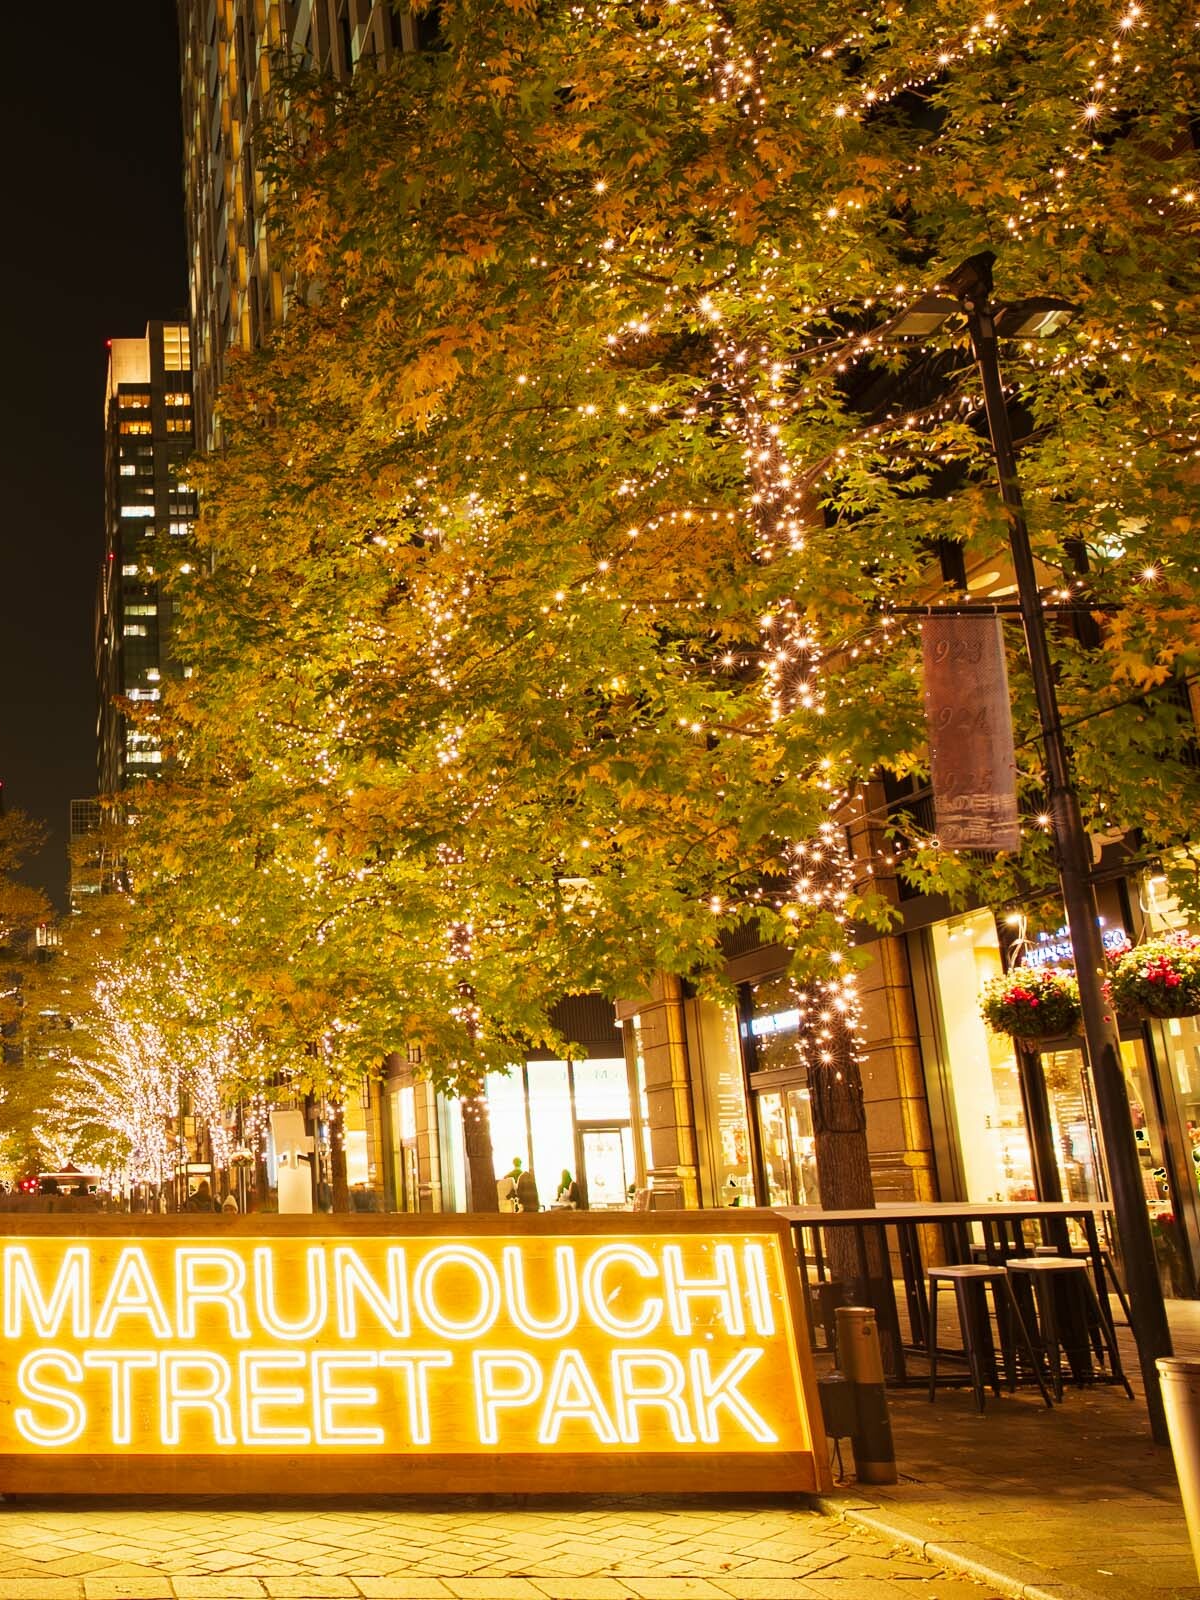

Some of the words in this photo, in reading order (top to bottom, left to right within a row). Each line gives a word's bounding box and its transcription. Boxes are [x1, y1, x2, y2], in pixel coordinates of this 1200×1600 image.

[3, 1245, 776, 1339] MARUNOUCHI
[13, 1346, 453, 1447] STREET
[471, 1346, 779, 1445] PARK
